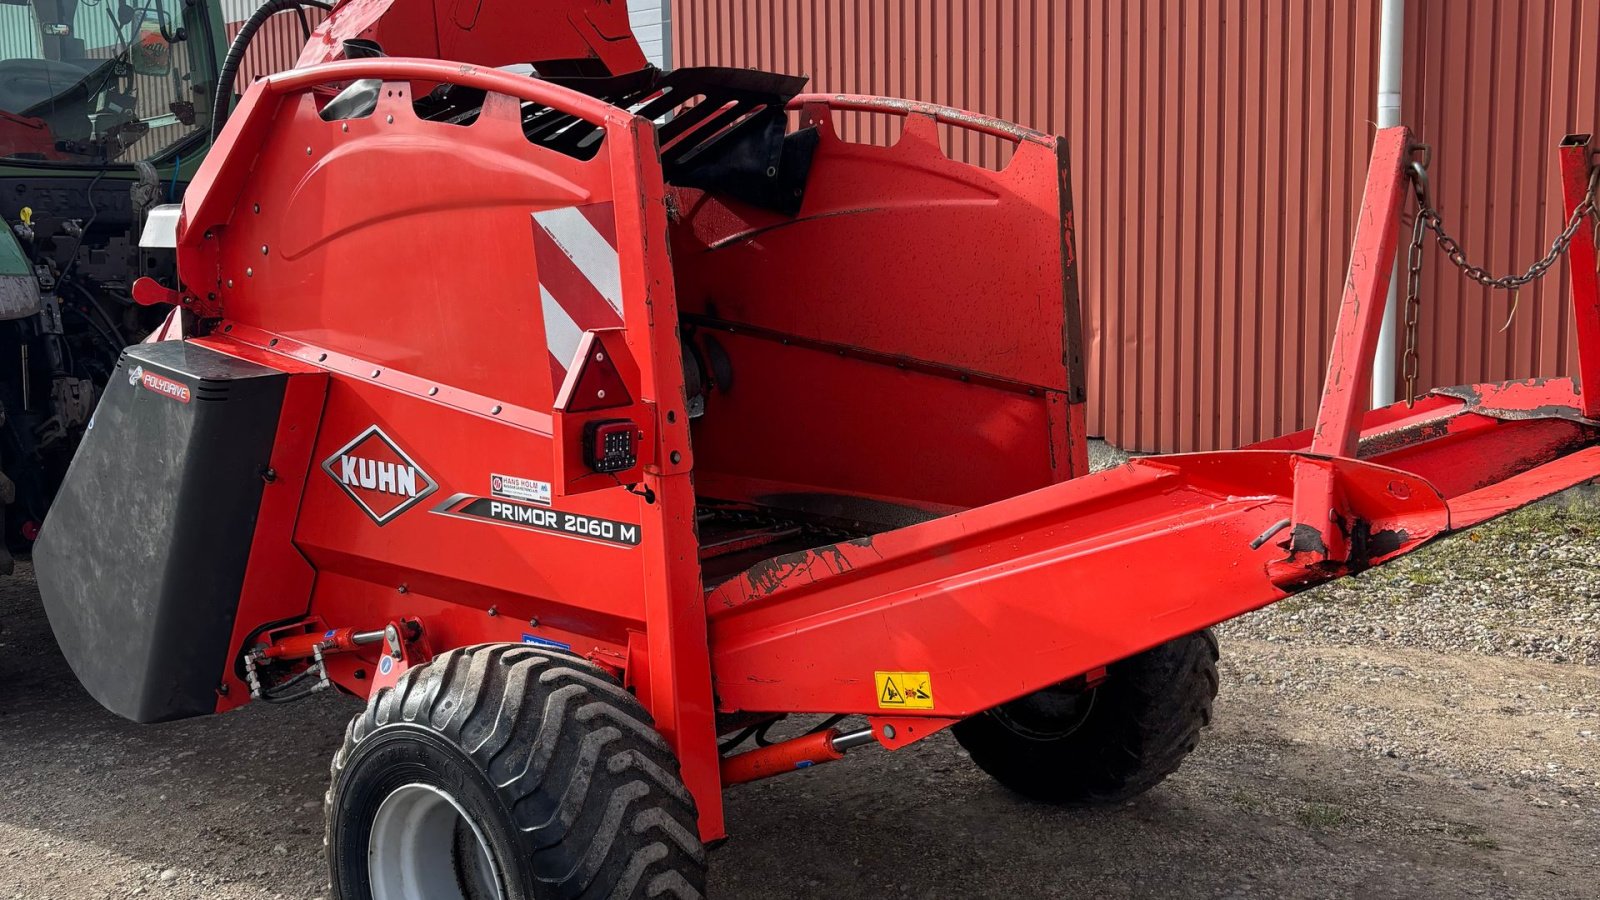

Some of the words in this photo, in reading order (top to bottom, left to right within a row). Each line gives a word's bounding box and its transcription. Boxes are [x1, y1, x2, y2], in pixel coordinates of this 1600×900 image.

[144, 374, 188, 399] POLYDRIVE
[341, 454, 416, 498] KUHN
[503, 477, 520, 486] HANS
[520, 480, 538, 489] HOLM
[491, 501, 558, 529] PRIMOR
[564, 515, 613, 539] 2060
[620, 525, 636, 543] M
